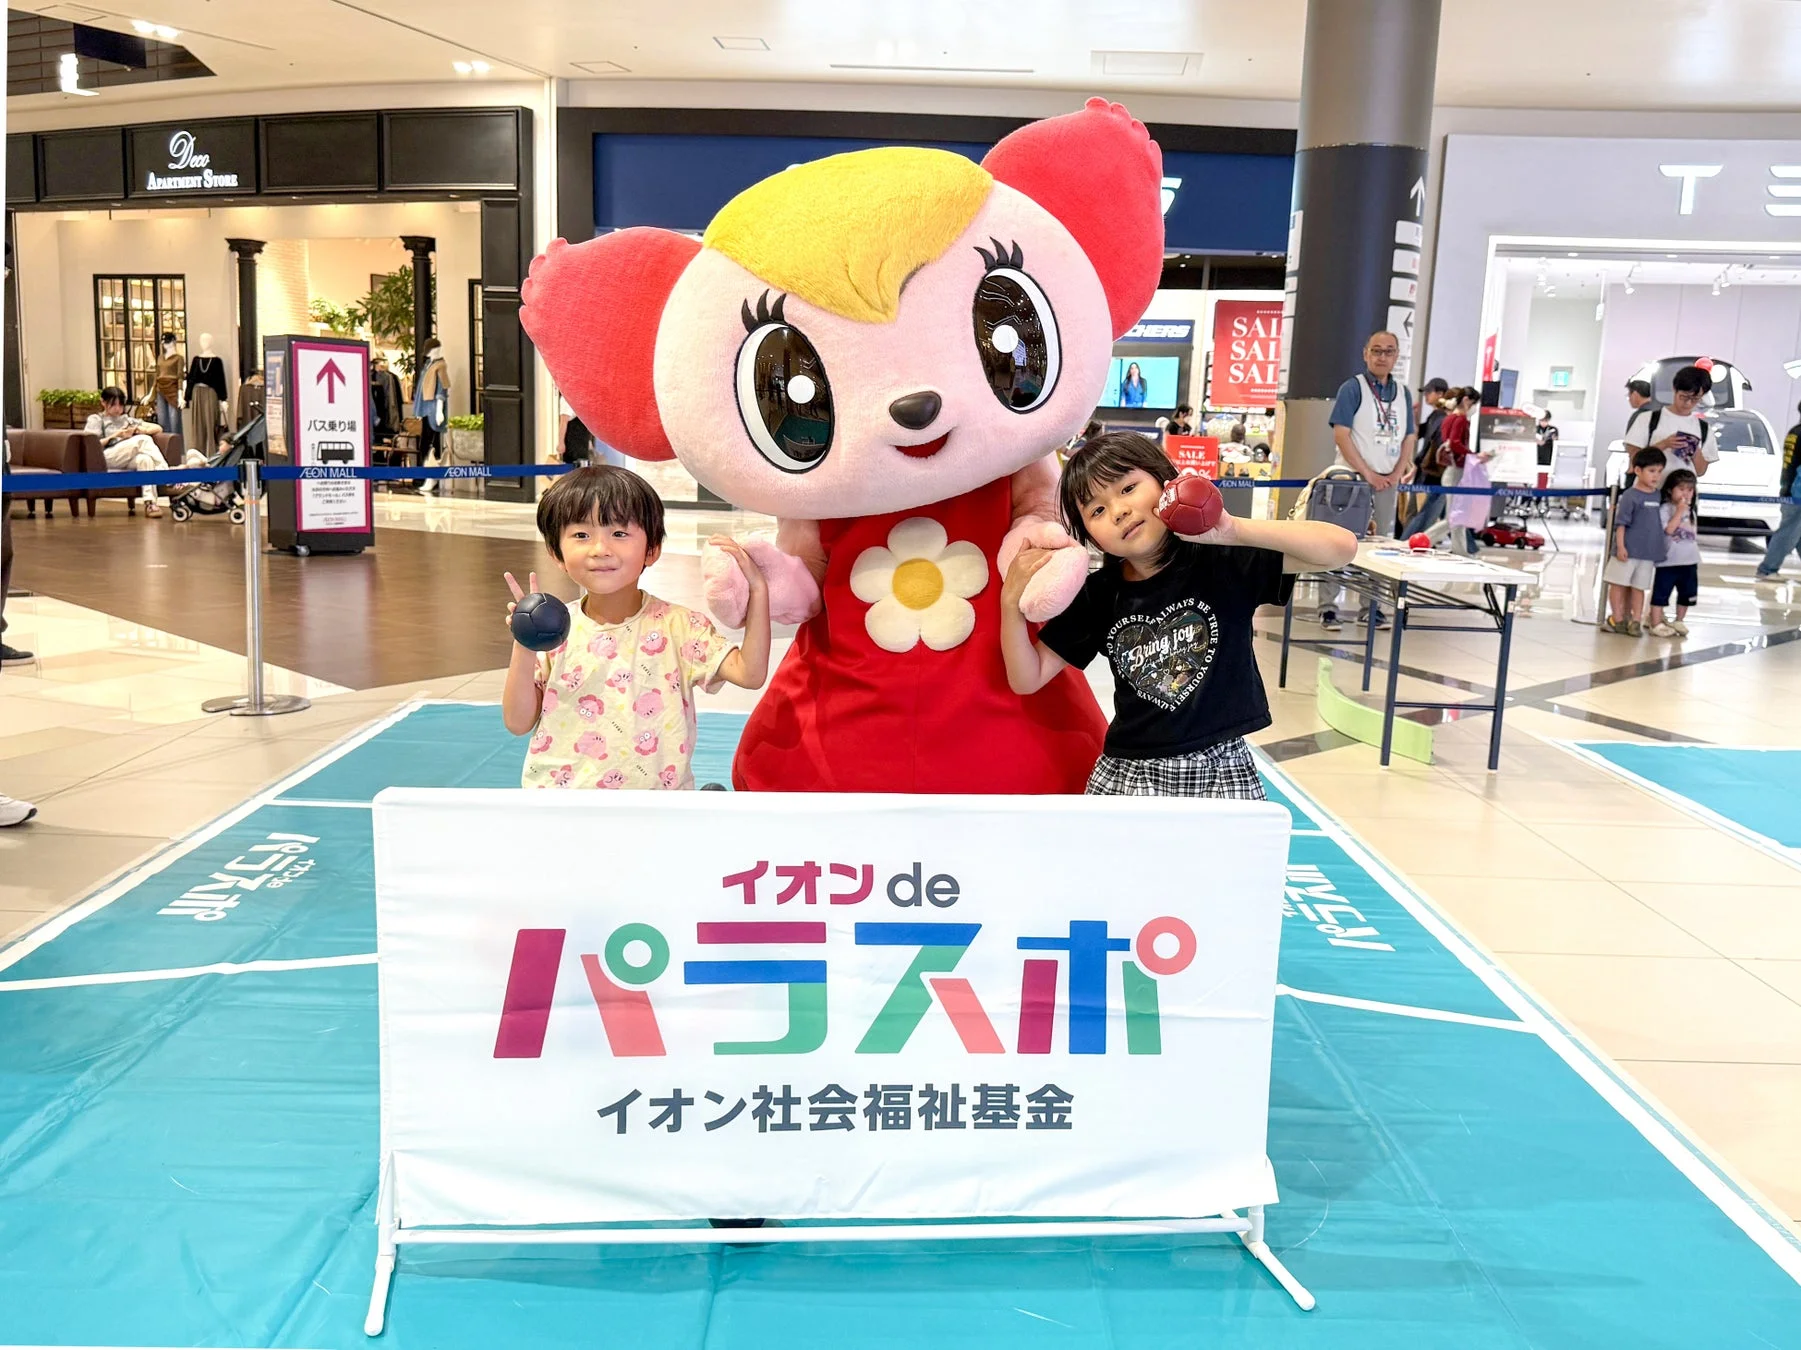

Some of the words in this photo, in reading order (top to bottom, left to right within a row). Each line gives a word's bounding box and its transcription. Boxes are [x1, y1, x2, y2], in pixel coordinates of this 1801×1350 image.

[168, 130, 210, 169] Deco
[307, 419, 357, 433] バス乗り場
[1178, 450, 1205, 460] SALE
[329, 467, 357, 478] MALL
[468, 467, 492, 477] MALL
[1238, 480, 1255, 488] MALL
[1156, 597, 1195, 625] ALWAYS
[1197, 600, 1211, 614] BE
[1107, 614, 1156, 641] YOURSELF
[1208, 614, 1219, 644] TRUE
[1131, 635, 1171, 671] Bring
[1173, 624, 1195, 650] joy
[1204, 648, 1216, 663] TO
[1168, 665, 1209, 712] YOURSELF
[722, 860, 874, 908] イオン
[886, 860, 962, 909] de
[493, 916, 1197, 1060] パラスポ
[596, 1083, 1075, 1133] イオン社会福祉基金
